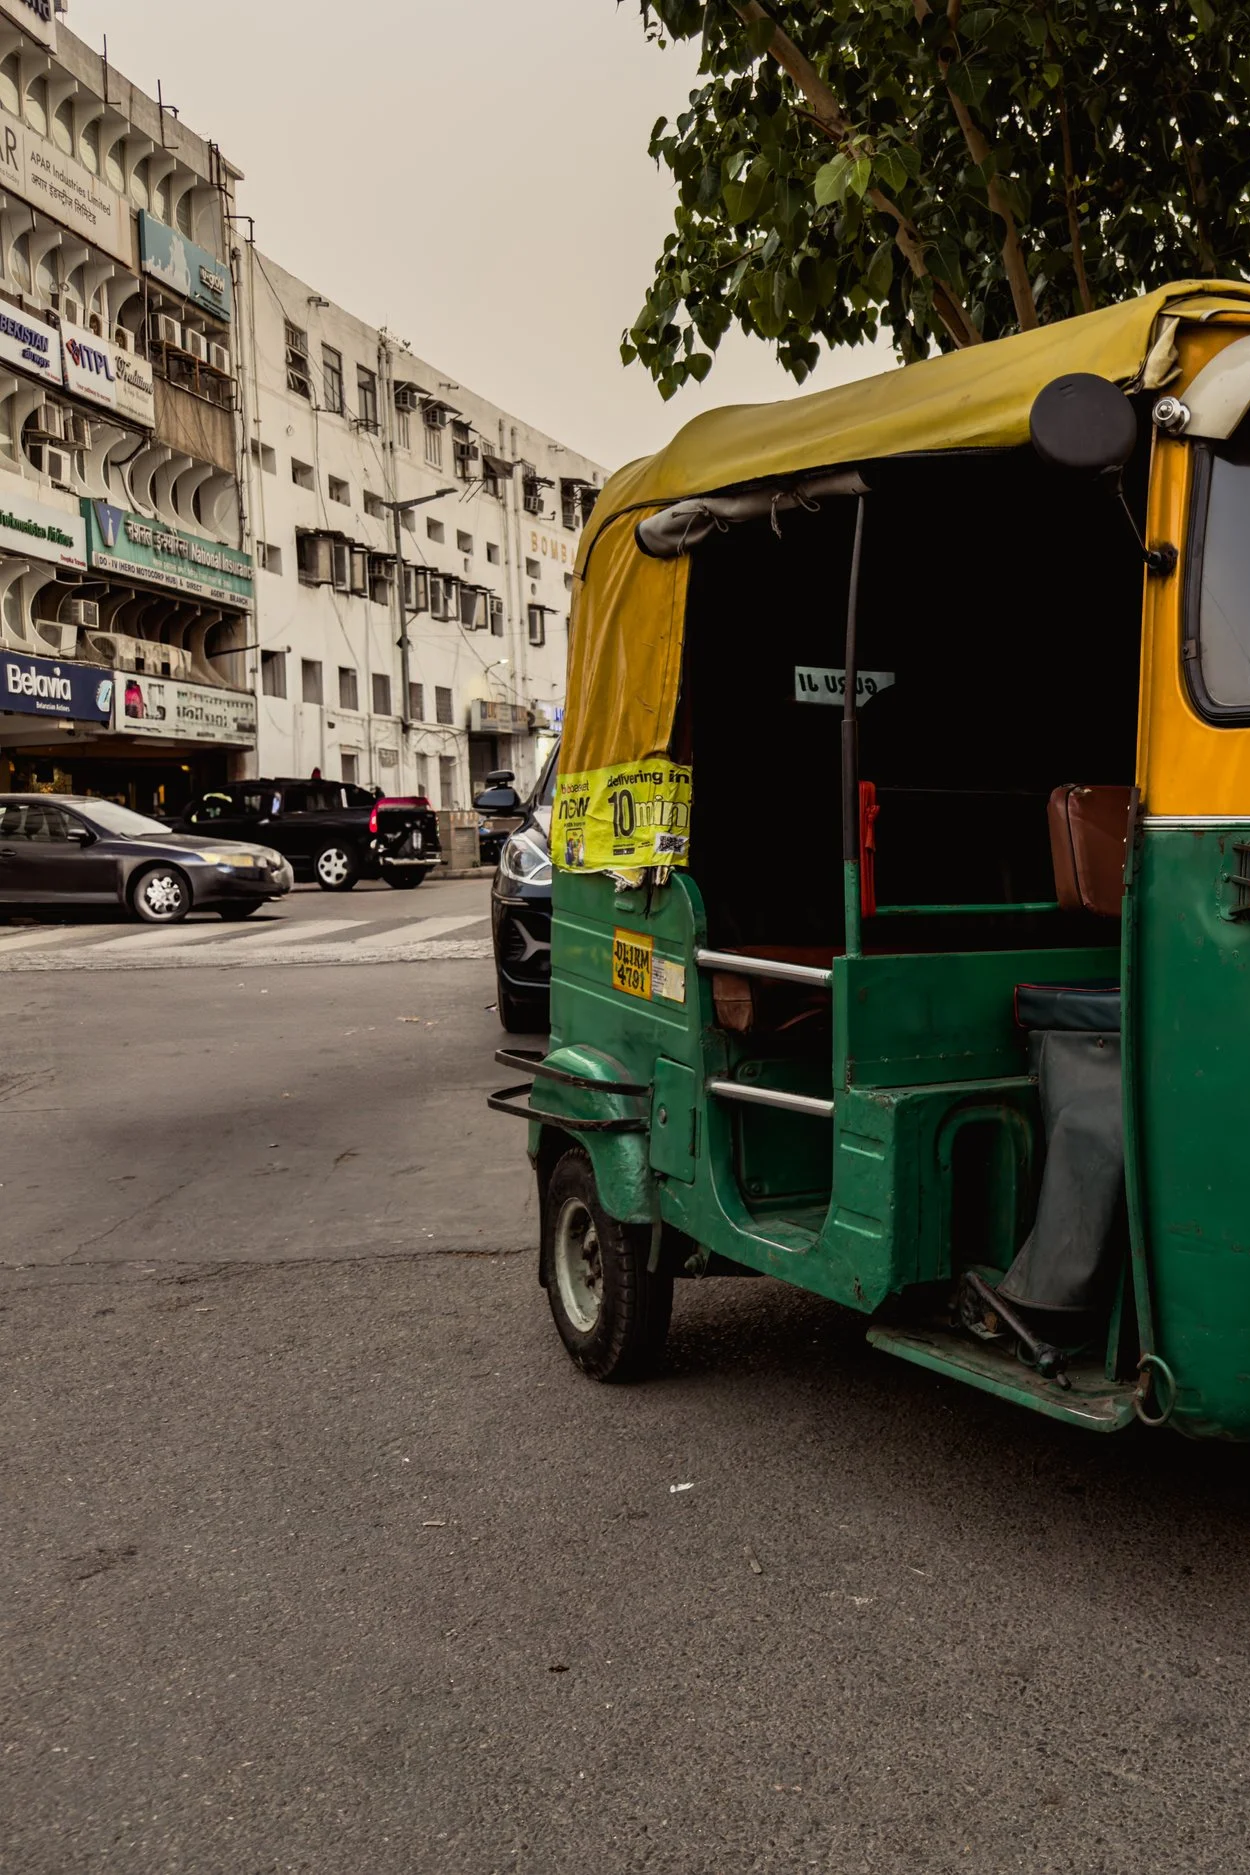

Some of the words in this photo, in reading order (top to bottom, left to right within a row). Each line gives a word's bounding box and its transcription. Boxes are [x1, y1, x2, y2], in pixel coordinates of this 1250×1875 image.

[30, 151, 51, 174] APAR
[52, 164, 87, 199] Industries
[87, 190, 111, 217] Limited
[22, 347, 50, 368] airways
[191, 542, 221, 570] National
[186, 581, 203, 593] DIRECT
[210, 589, 225, 599] AGENT
[6, 664, 72, 701] Belavia
[607, 770, 663, 788] delivering
[669, 769, 690, 784] in
[559, 797, 591, 820] now
[607, 788, 635, 838] 10
[616, 963, 645, 993] 4791
